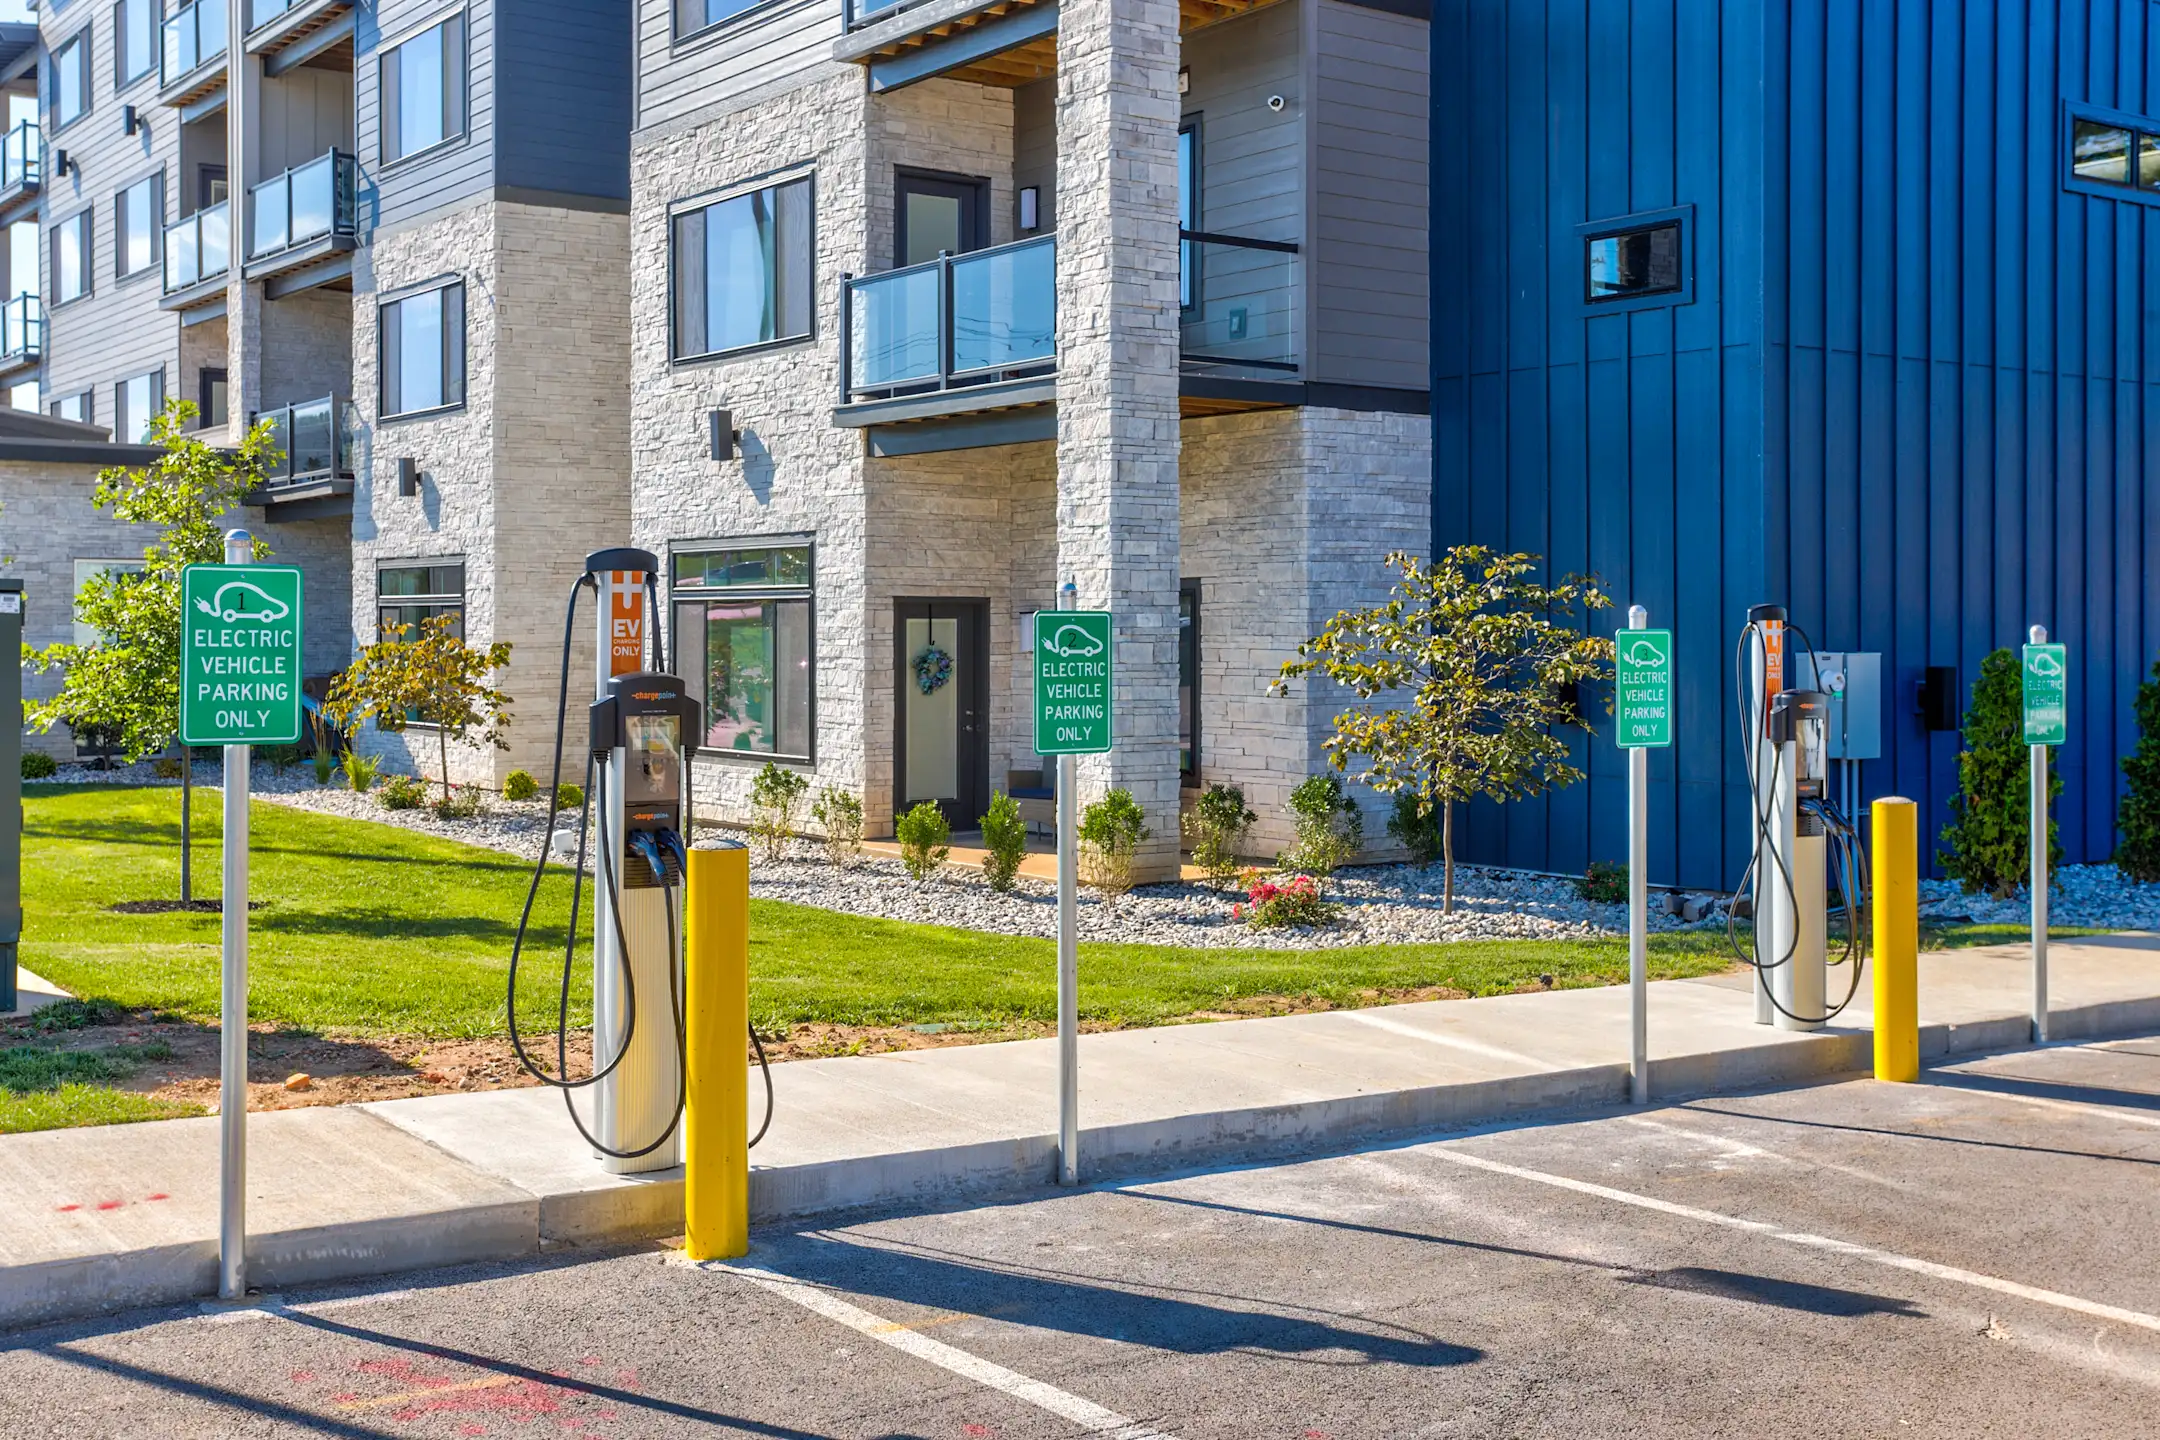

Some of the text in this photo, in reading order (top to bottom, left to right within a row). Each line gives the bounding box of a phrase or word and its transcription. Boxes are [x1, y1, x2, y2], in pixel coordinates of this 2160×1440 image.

[238, 592, 245, 610] 1
[613, 618, 640, 638] EV
[195, 629, 293, 648] ELECTRIC
[1068, 632, 1077, 648] 2
[612, 646, 640, 657] ONLY
[1641, 648, 1649, 661] 3
[201, 656, 286, 675] VEHICLE
[1767, 652, 1781, 667] EV
[1042, 662, 1106, 677] ELECTRIC
[1622, 671, 1667, 685] ELECTRIC
[2028, 679, 2062, 691] ELECTRIC
[198, 682, 288, 701] PARKING
[1046, 683, 1102, 699] VEHICLE
[1625, 689, 1664, 702] VEHICLE
[2031, 694, 2060, 706] VEHICLE
[215, 709, 271, 729] ONLY
[1045, 704, 1103, 720] PARKING
[1624, 706, 1665, 719] PARKING
[1056, 726, 1092, 742] ONLY
[1632, 724, 1658, 737] ONLY
[2036, 724, 2056, 736] ONLY
